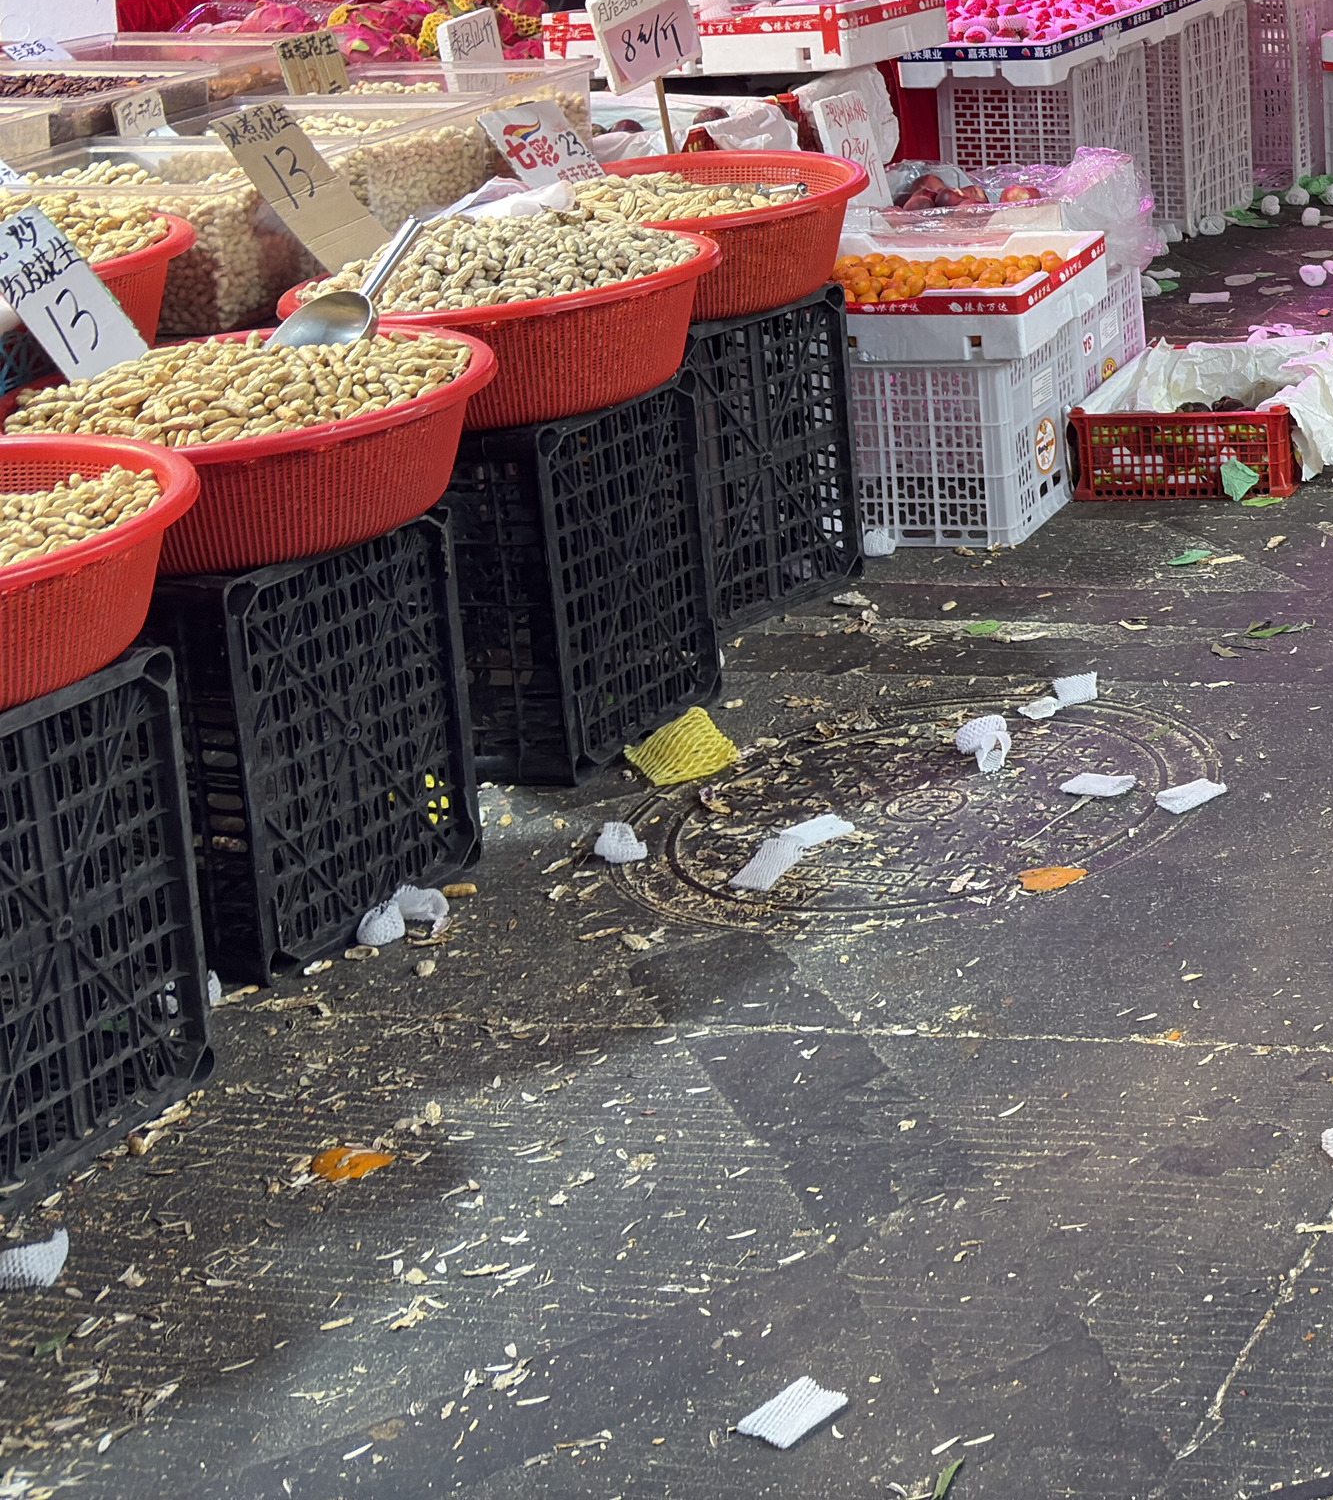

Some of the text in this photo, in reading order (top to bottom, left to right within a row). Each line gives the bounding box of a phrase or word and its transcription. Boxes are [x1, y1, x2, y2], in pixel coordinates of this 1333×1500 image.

[967, 47, 1008, 59] 嘉禾果业
[224, 103, 298, 149] 水煮花生
[502, 136, 560, 171] 七彩
[264, 146, 315, 210] 13
[44, 288, 100, 366] 13
